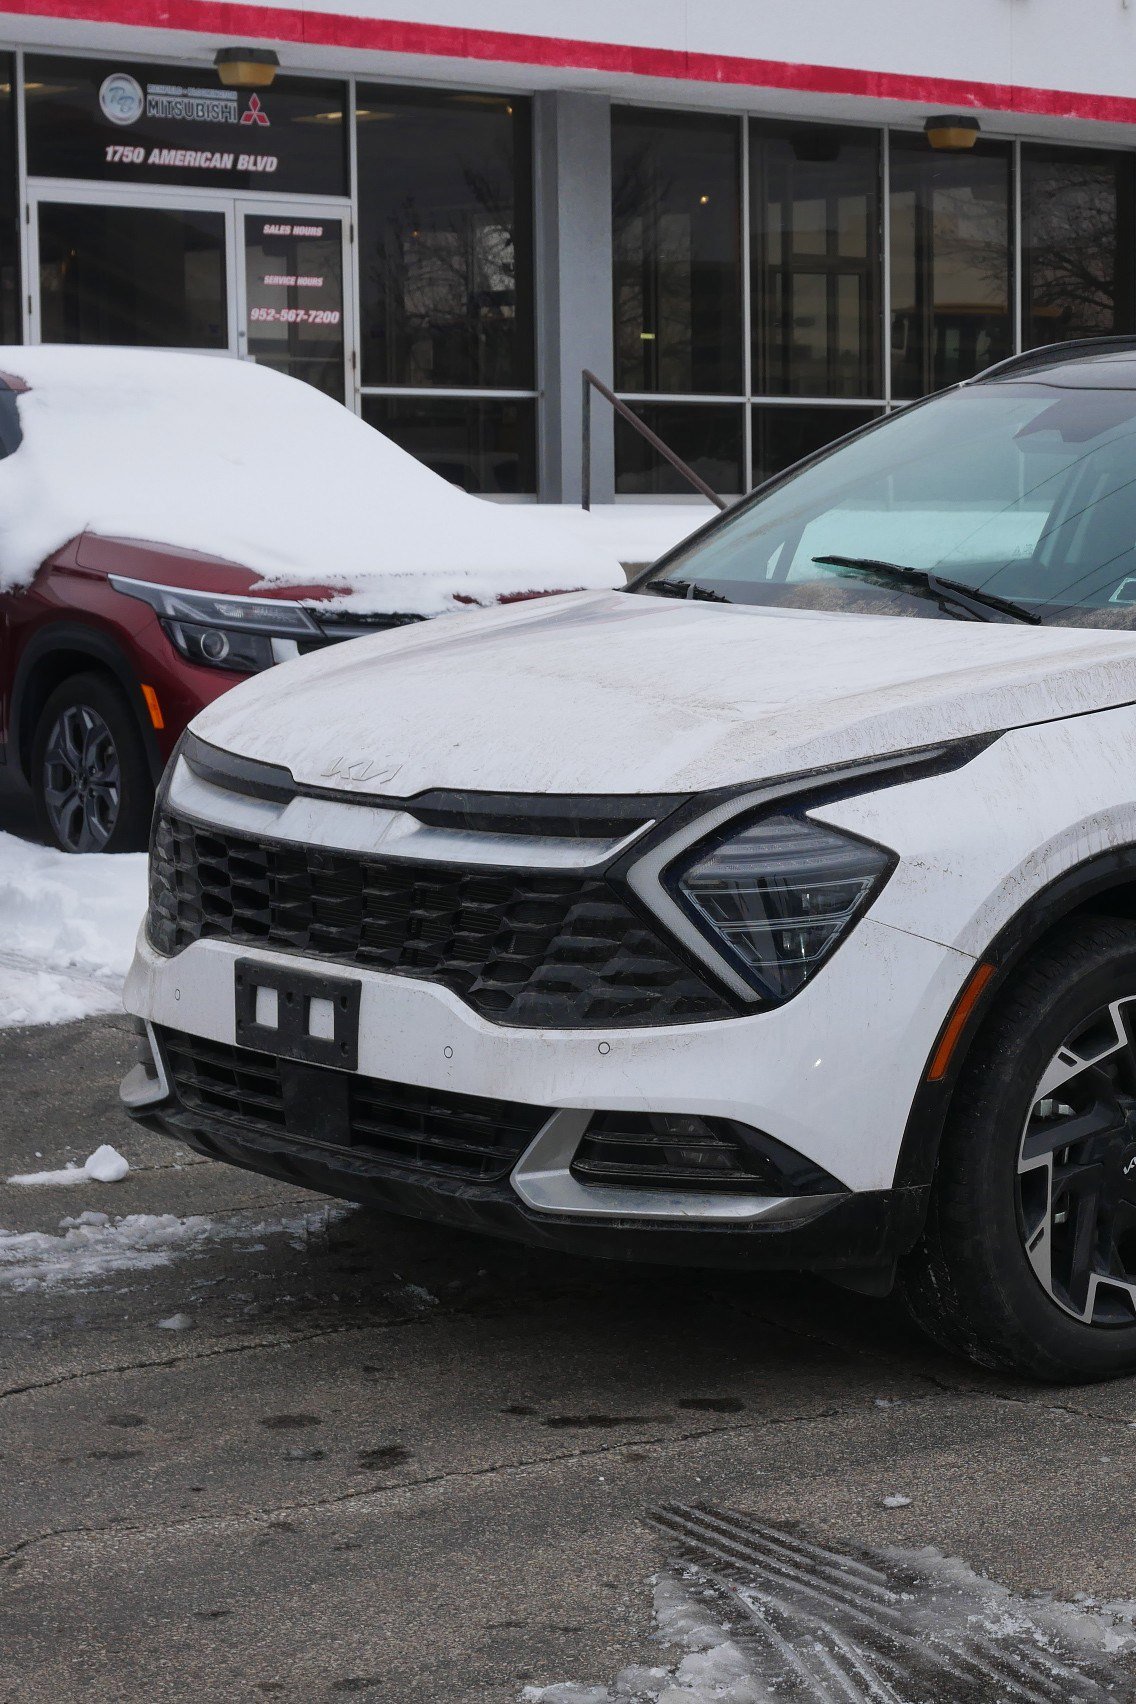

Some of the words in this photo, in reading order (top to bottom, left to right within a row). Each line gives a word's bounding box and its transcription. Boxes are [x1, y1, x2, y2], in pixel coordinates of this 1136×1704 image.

[147, 98, 238, 122] MITSUBISHI
[105, 145, 145, 163] 1750
[147, 148, 234, 170] AMERICAN
[236, 154, 278, 172] BLVD
[263, 224, 292, 236] SALES
[292, 225, 323, 237] HOURS
[263, 275, 297, 287] SERVICE
[296, 276, 323, 288] HOURS
[250, 307, 340, 325] 952-567-7200
